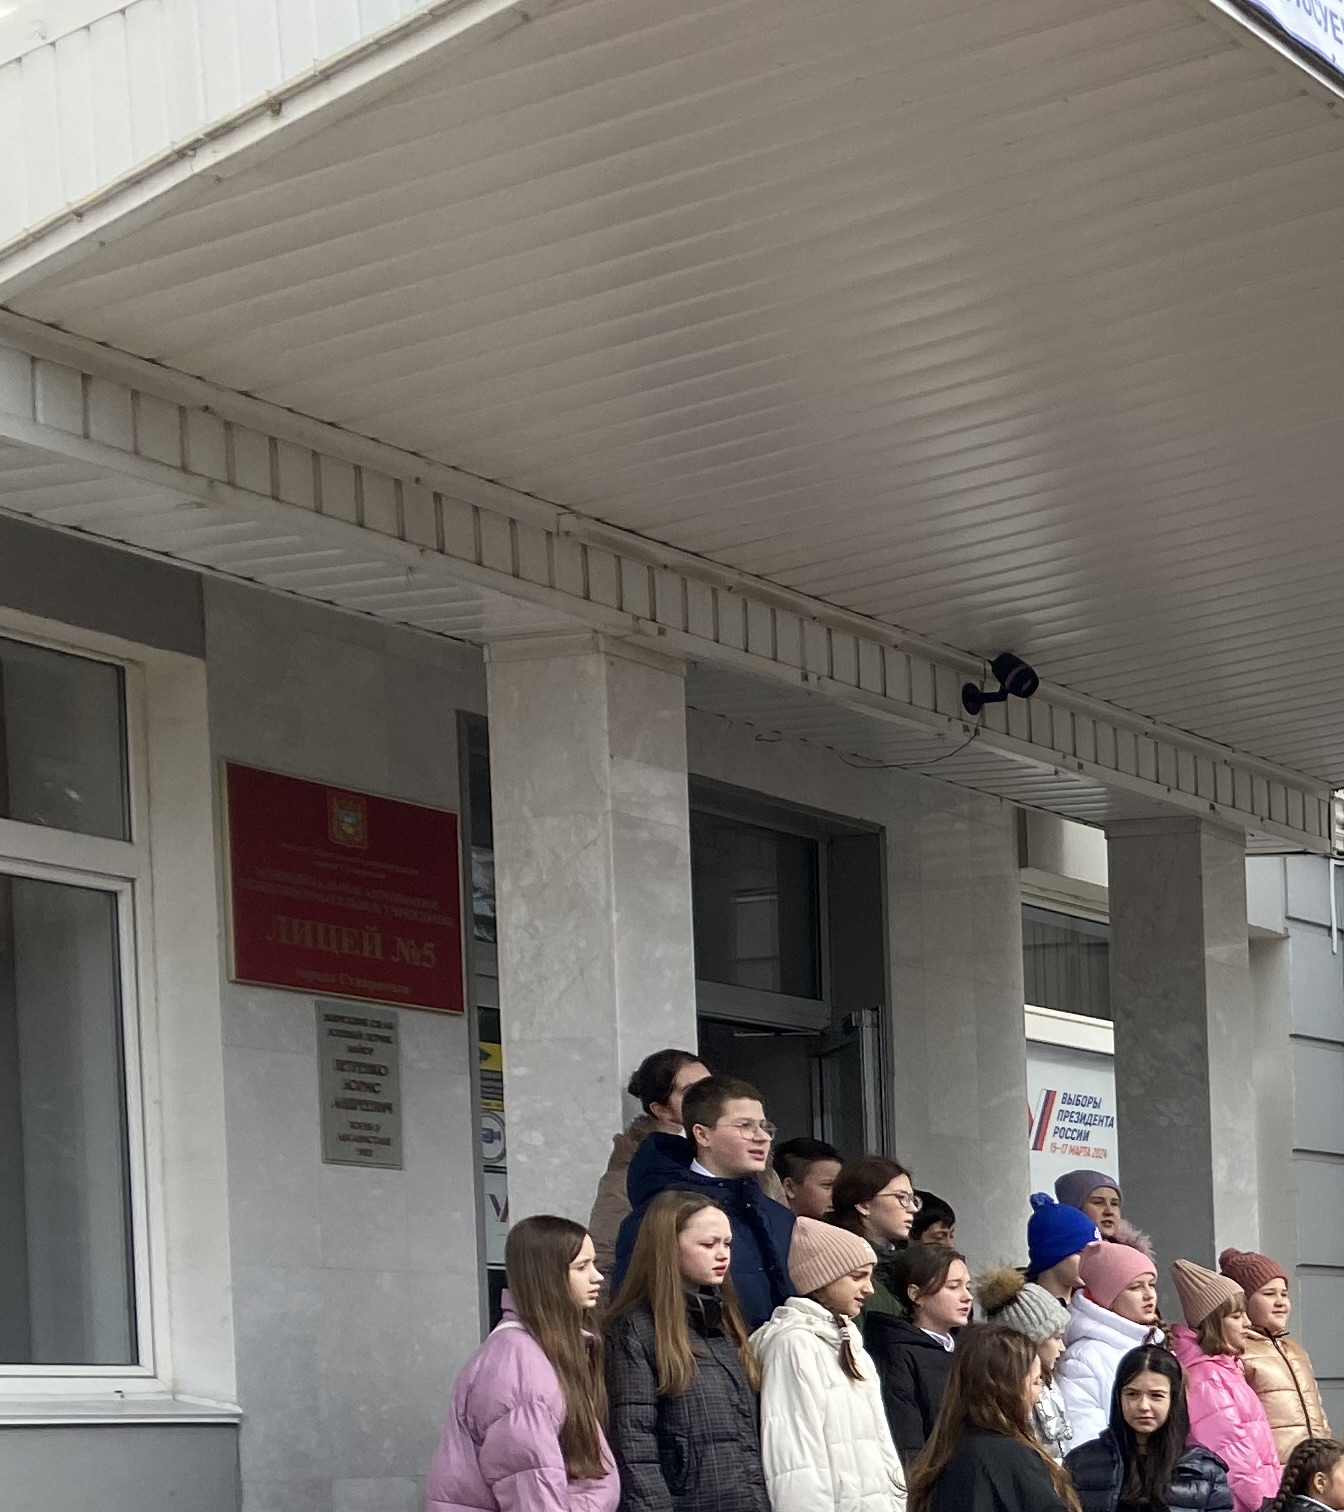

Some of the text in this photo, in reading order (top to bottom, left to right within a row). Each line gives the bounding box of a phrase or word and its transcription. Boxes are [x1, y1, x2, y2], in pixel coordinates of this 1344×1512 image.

[265, 914, 436, 968] ЛИЦЕЙ №5
[1061, 1092, 1102, 1109] ВЫБОРЫ
[1056, 1109, 1115, 1128] ПРЕЗИДЕНТА
[1053, 1125, 1090, 1142] РОССИИ
